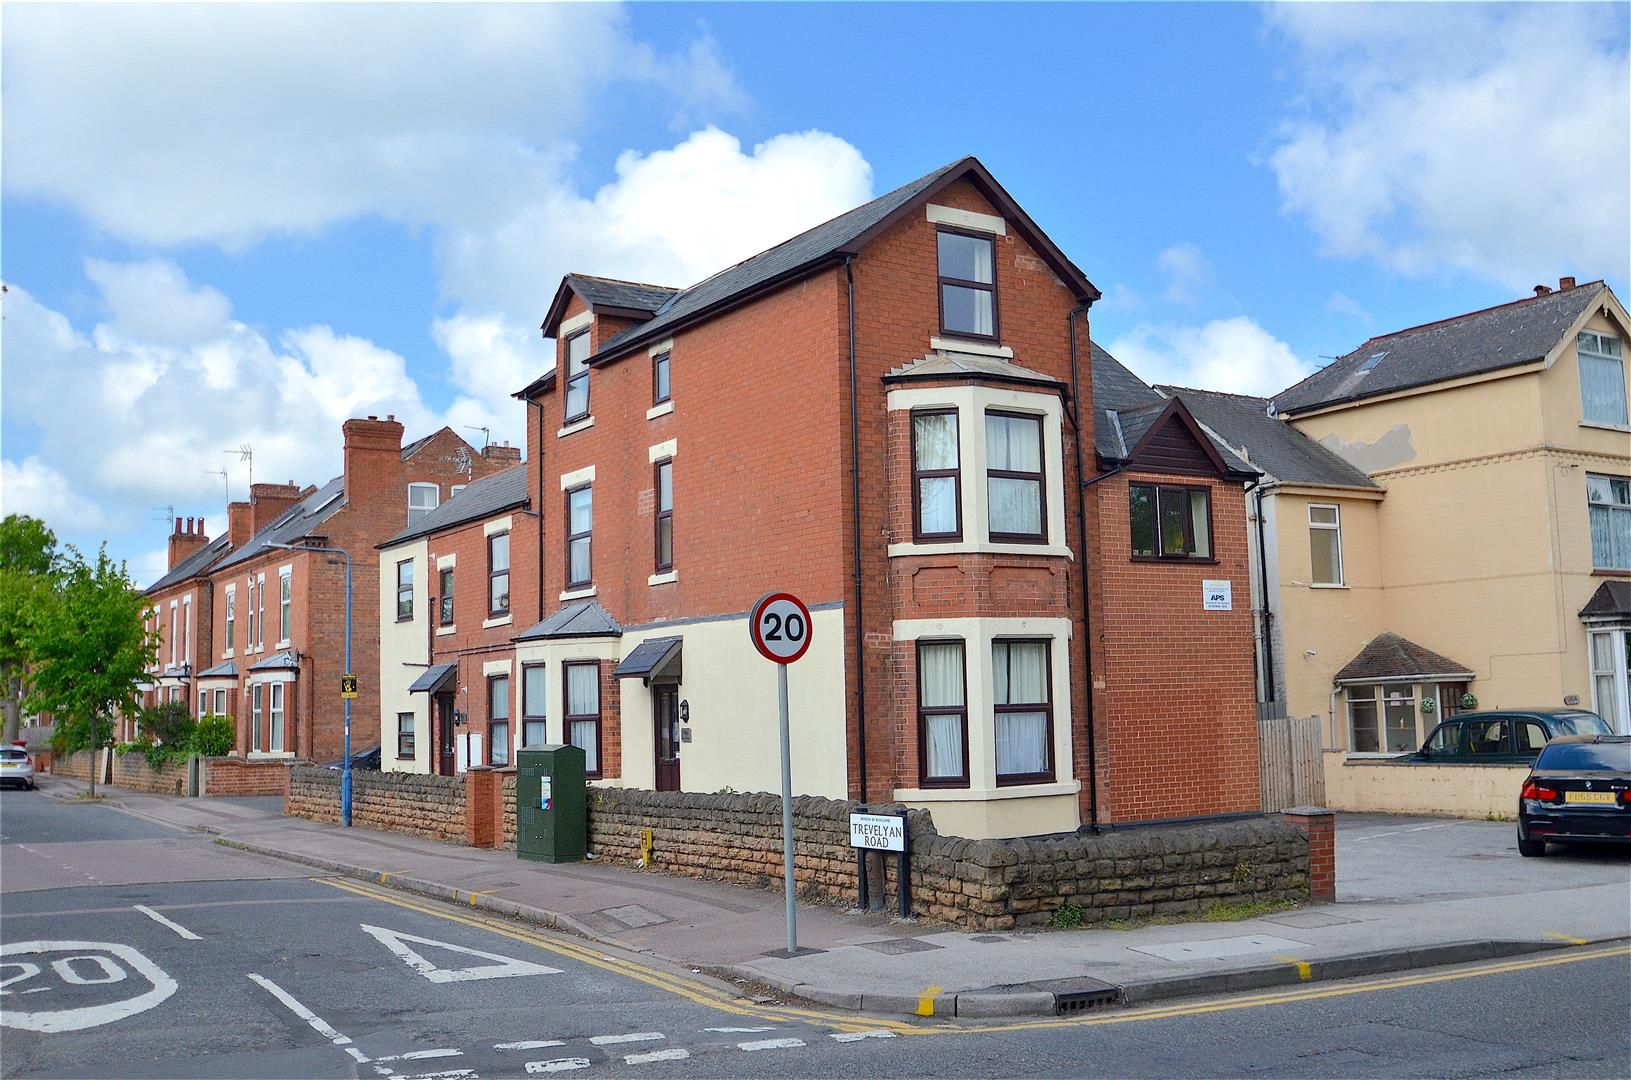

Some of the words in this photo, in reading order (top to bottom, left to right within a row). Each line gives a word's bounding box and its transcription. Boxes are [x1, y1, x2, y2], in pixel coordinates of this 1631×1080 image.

[763, 612, 804, 642] 20
[852, 823, 902, 838] TREVELYAN
[864, 835, 889, 848] ROAD
